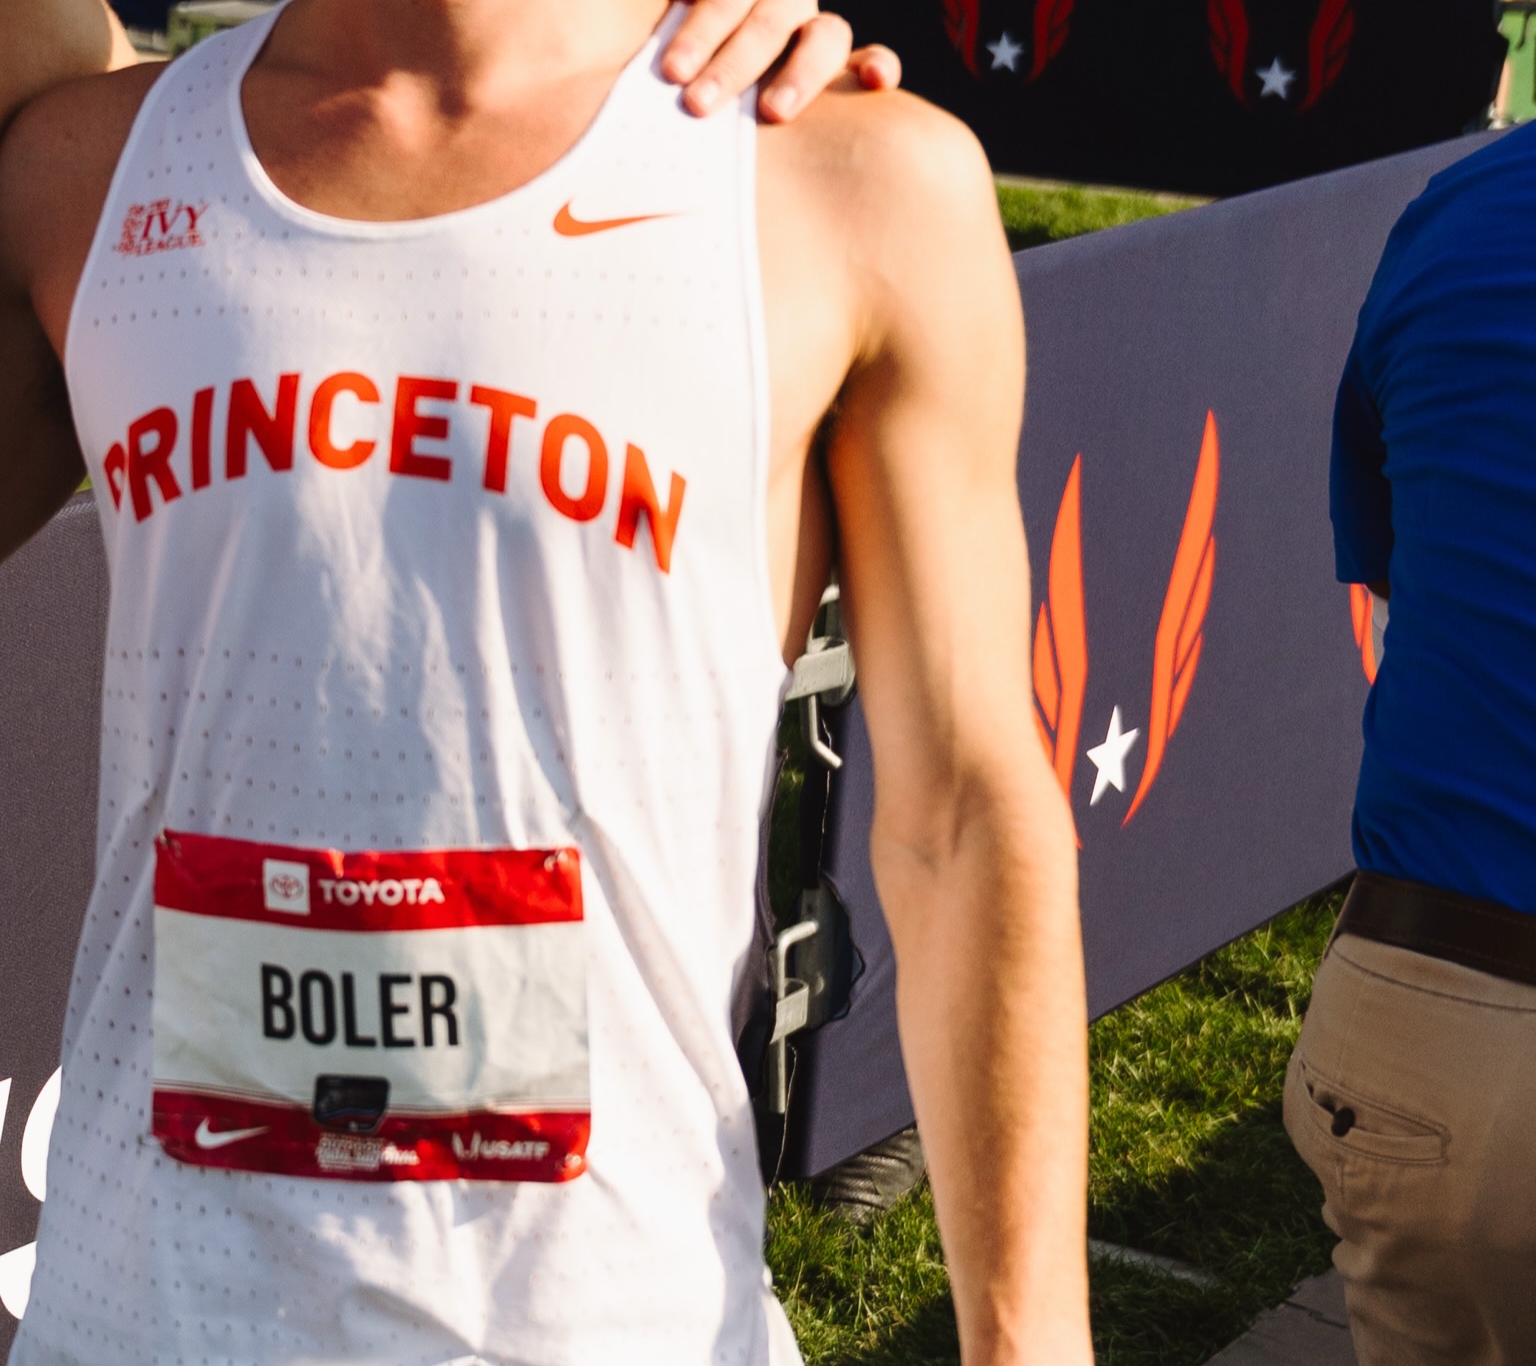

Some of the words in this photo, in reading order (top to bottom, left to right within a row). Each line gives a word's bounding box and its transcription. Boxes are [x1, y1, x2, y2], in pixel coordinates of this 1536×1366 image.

[141, 202, 209, 240] IVY
[102, 370, 687, 575] PRINCETON
[317, 877, 446, 906] TOYOTA
[260, 961, 460, 1048] BOLER
[480, 1140, 550, 1160] USATF
